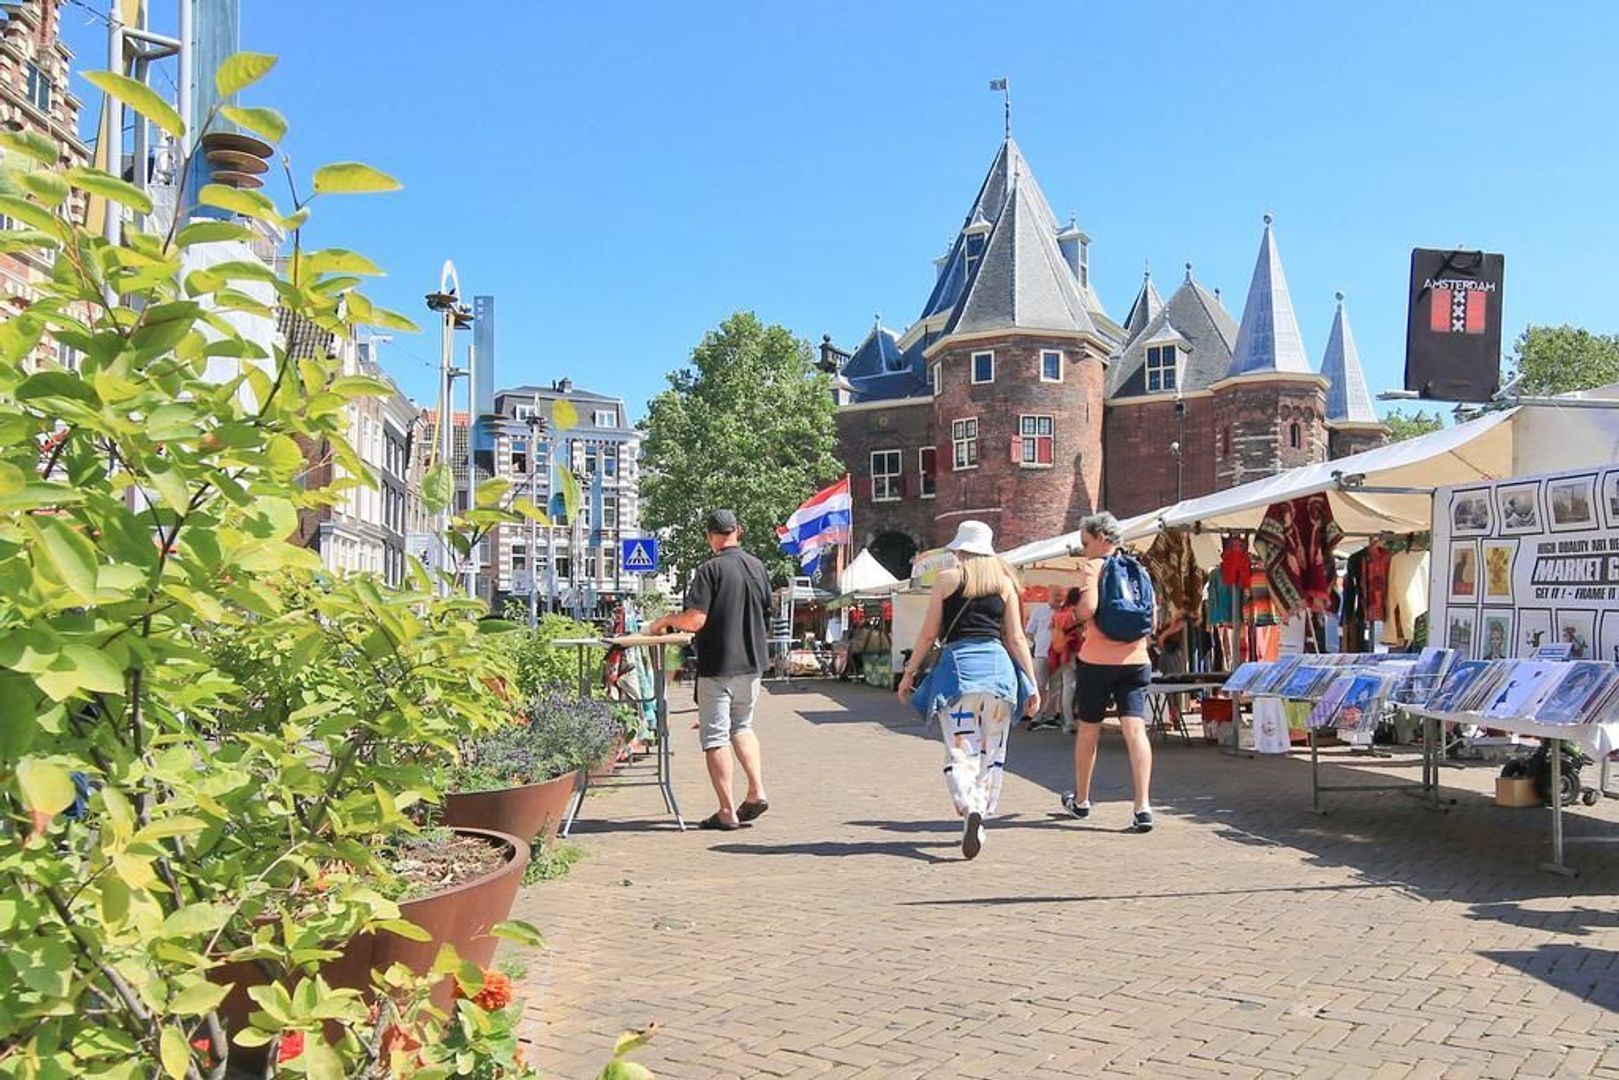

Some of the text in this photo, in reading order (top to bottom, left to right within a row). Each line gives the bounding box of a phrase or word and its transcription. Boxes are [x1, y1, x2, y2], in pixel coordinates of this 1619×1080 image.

[1423, 278, 1496, 292] AMSTERDAM
[1558, 541, 1589, 553] QUALITY
[1592, 539, 1607, 551] ART
[1533, 559, 1603, 581] MARKET
[1535, 588, 1549, 599] GET
[1551, 588, 1560, 599] IT
[1575, 588, 1606, 600] FRAME
[1608, 588, 1616, 600] IT
